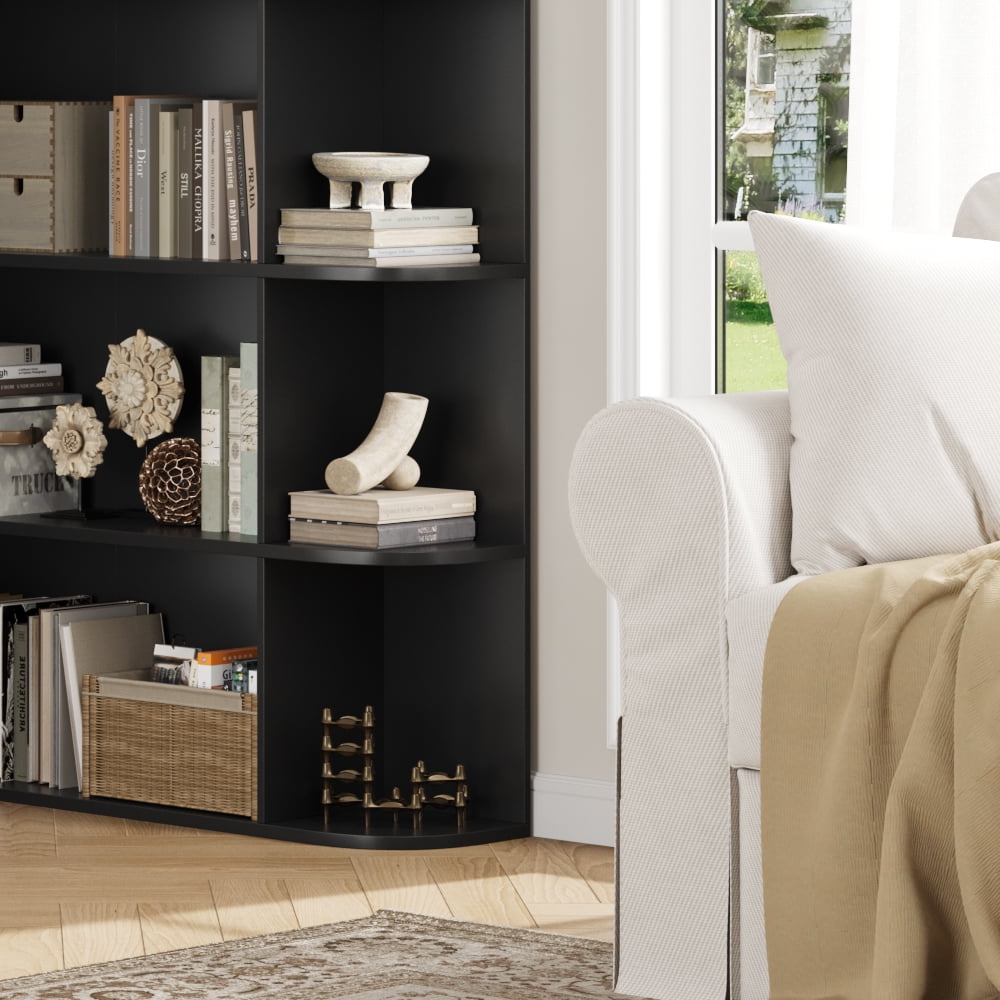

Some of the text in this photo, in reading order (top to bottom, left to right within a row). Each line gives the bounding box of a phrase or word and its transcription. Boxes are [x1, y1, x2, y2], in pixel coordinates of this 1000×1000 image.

[136, 148, 147, 178] Dior
[194, 128, 202, 232] MALLIKA CHOPRA
[180, 172, 189, 199] STILL
[224, 130, 239, 241] Sigrid Rausing mayhem
[248, 167, 256, 209] PRADA
